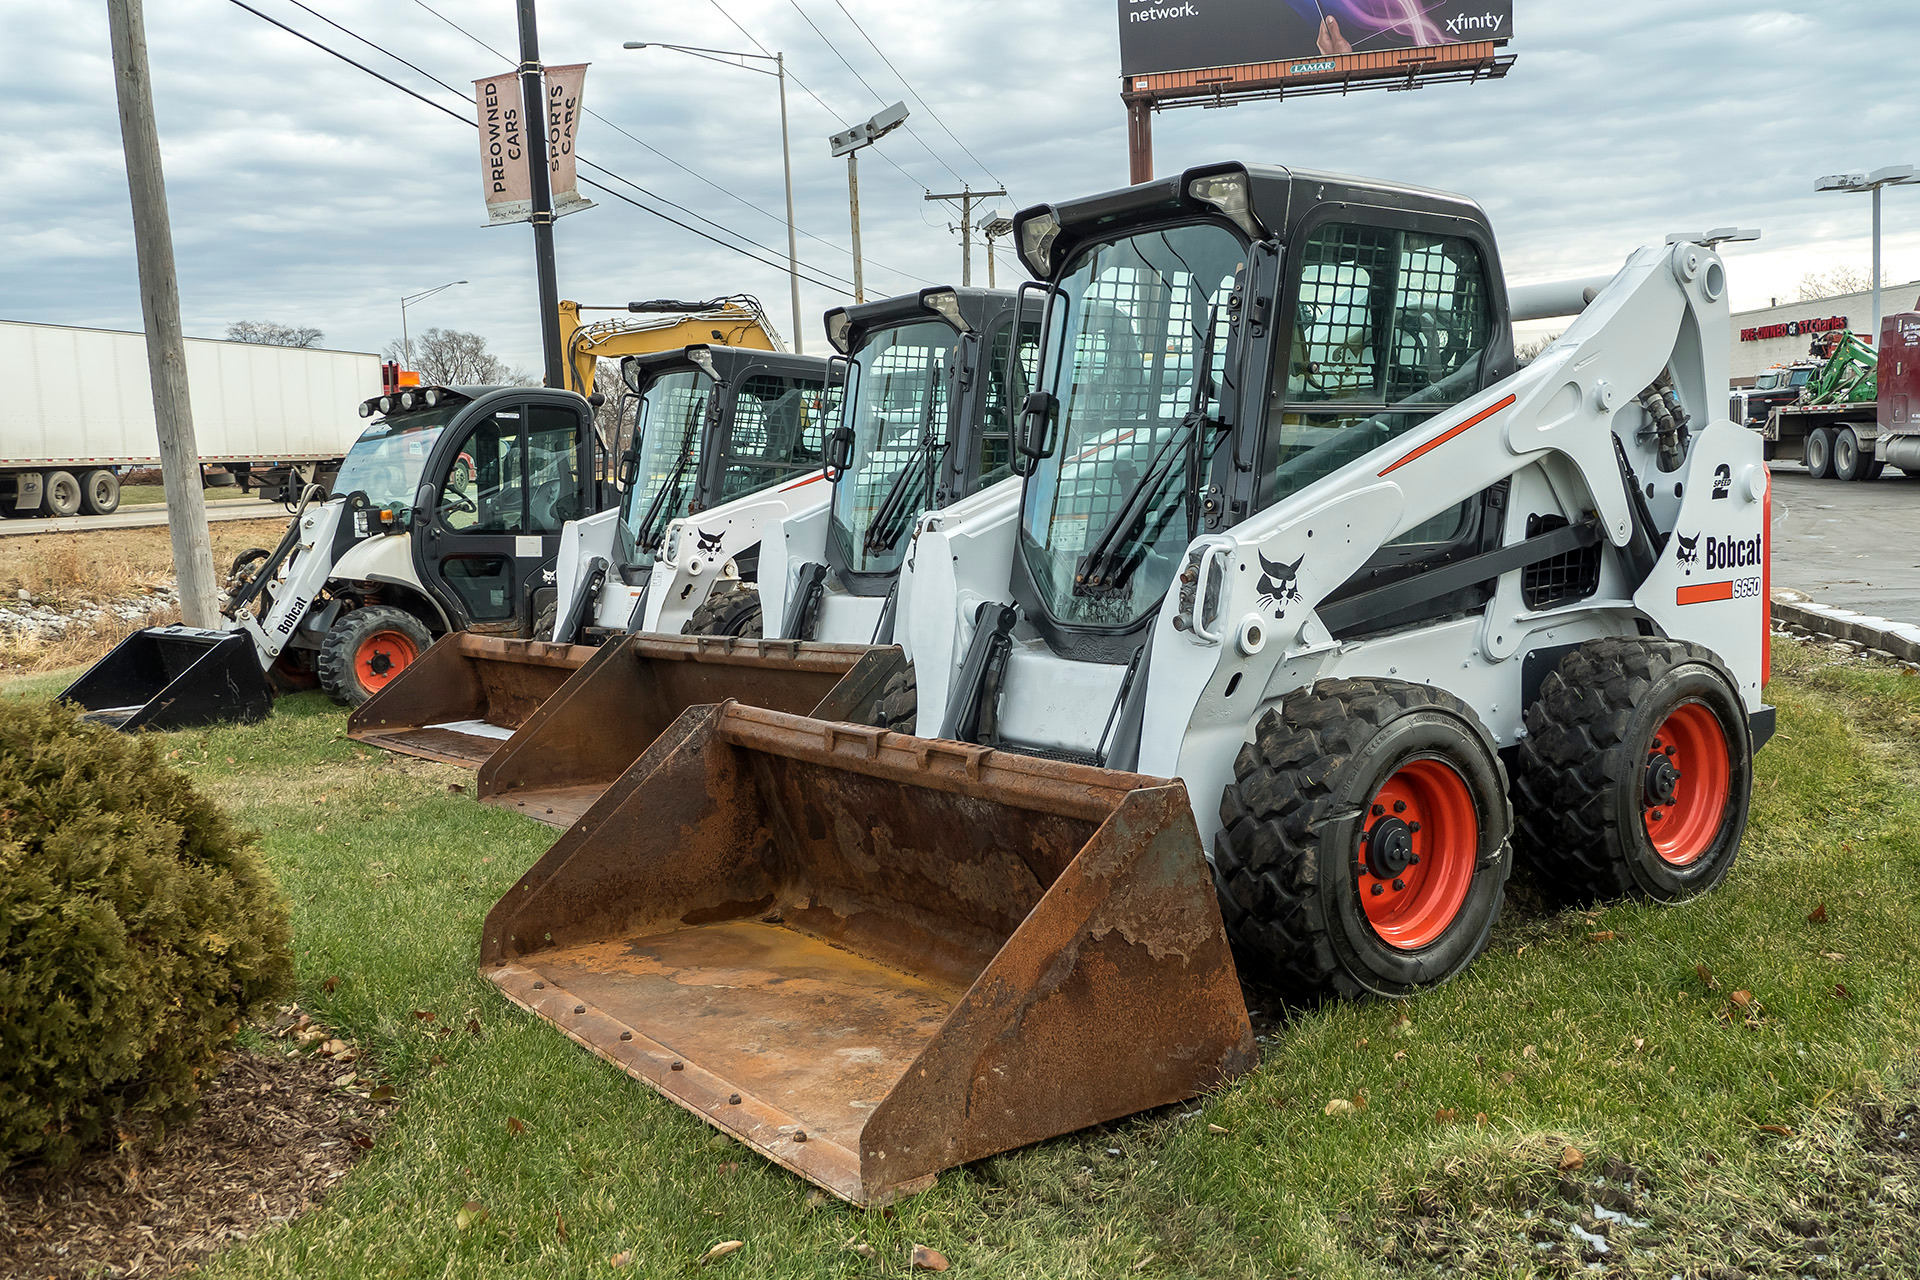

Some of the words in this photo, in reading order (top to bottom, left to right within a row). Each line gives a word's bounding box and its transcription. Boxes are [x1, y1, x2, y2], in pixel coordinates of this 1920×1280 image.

[1130, 1, 1199, 23] network.
[1446, 12, 1504, 34] xfinity
[1294, 62, 1332, 73] LAMAR
[486, 83, 506, 192] PREOWNED
[504, 108, 521, 161] CARS
[551, 85, 564, 172] SPORTS
[561, 96, 576, 155] CARS
[1740, 322, 1787, 342] PRE-OWNED
[1711, 463, 1731, 500] 2
[1713, 478, 1731, 488] SPEED
[1706, 533, 1762, 570] Bobcat
[1733, 576, 1761, 599] S650
[277, 596, 307, 635] Bobcat
